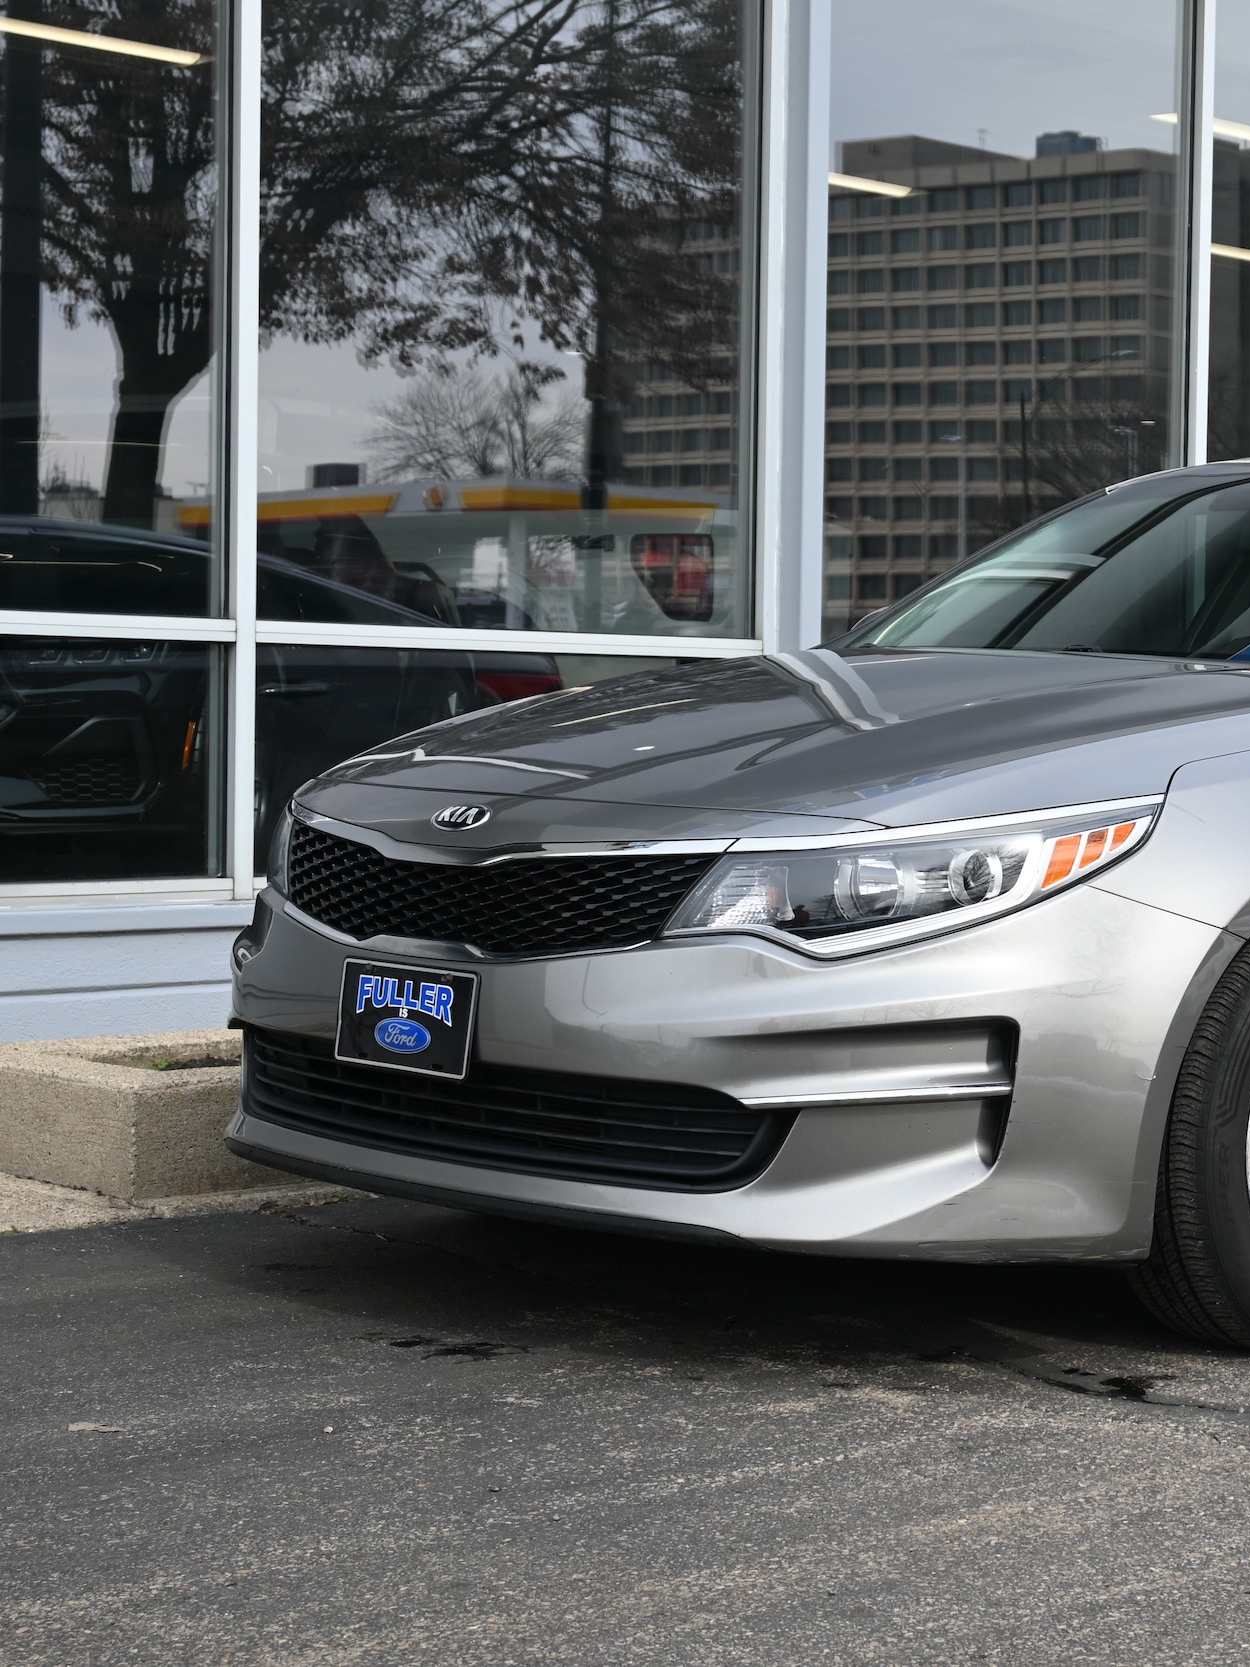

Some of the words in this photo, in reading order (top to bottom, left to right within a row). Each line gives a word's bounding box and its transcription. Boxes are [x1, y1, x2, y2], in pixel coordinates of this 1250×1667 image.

[437, 806, 480, 824] KIA
[356, 974, 454, 1028] FULLER
[399, 1008, 409, 1017] IS
[384, 1023, 418, 1047] Ford
